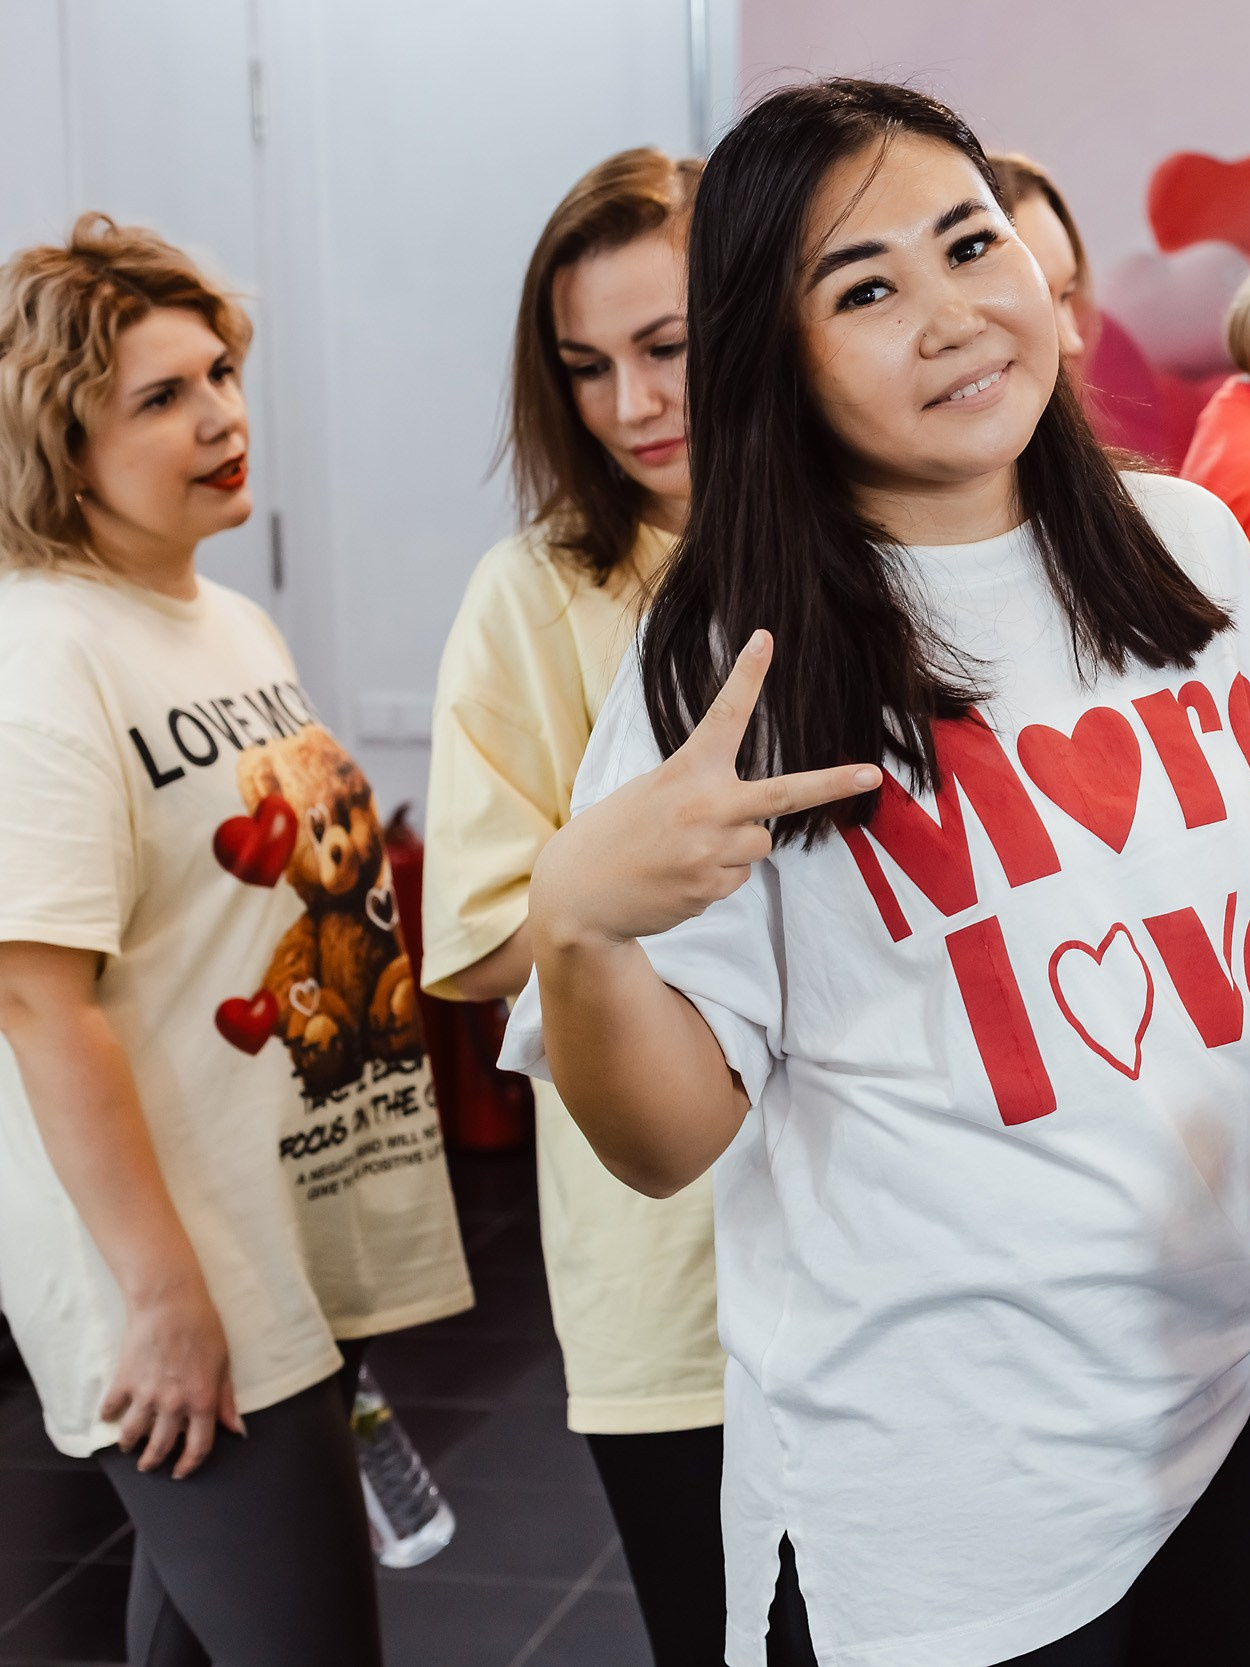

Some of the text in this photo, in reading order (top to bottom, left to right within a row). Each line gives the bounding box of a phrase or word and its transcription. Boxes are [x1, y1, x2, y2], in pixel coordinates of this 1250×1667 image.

[128, 698, 267, 790] LOVE
[279, 1115, 348, 1163] FOCUS
[371, 1086, 419, 1124] THE
